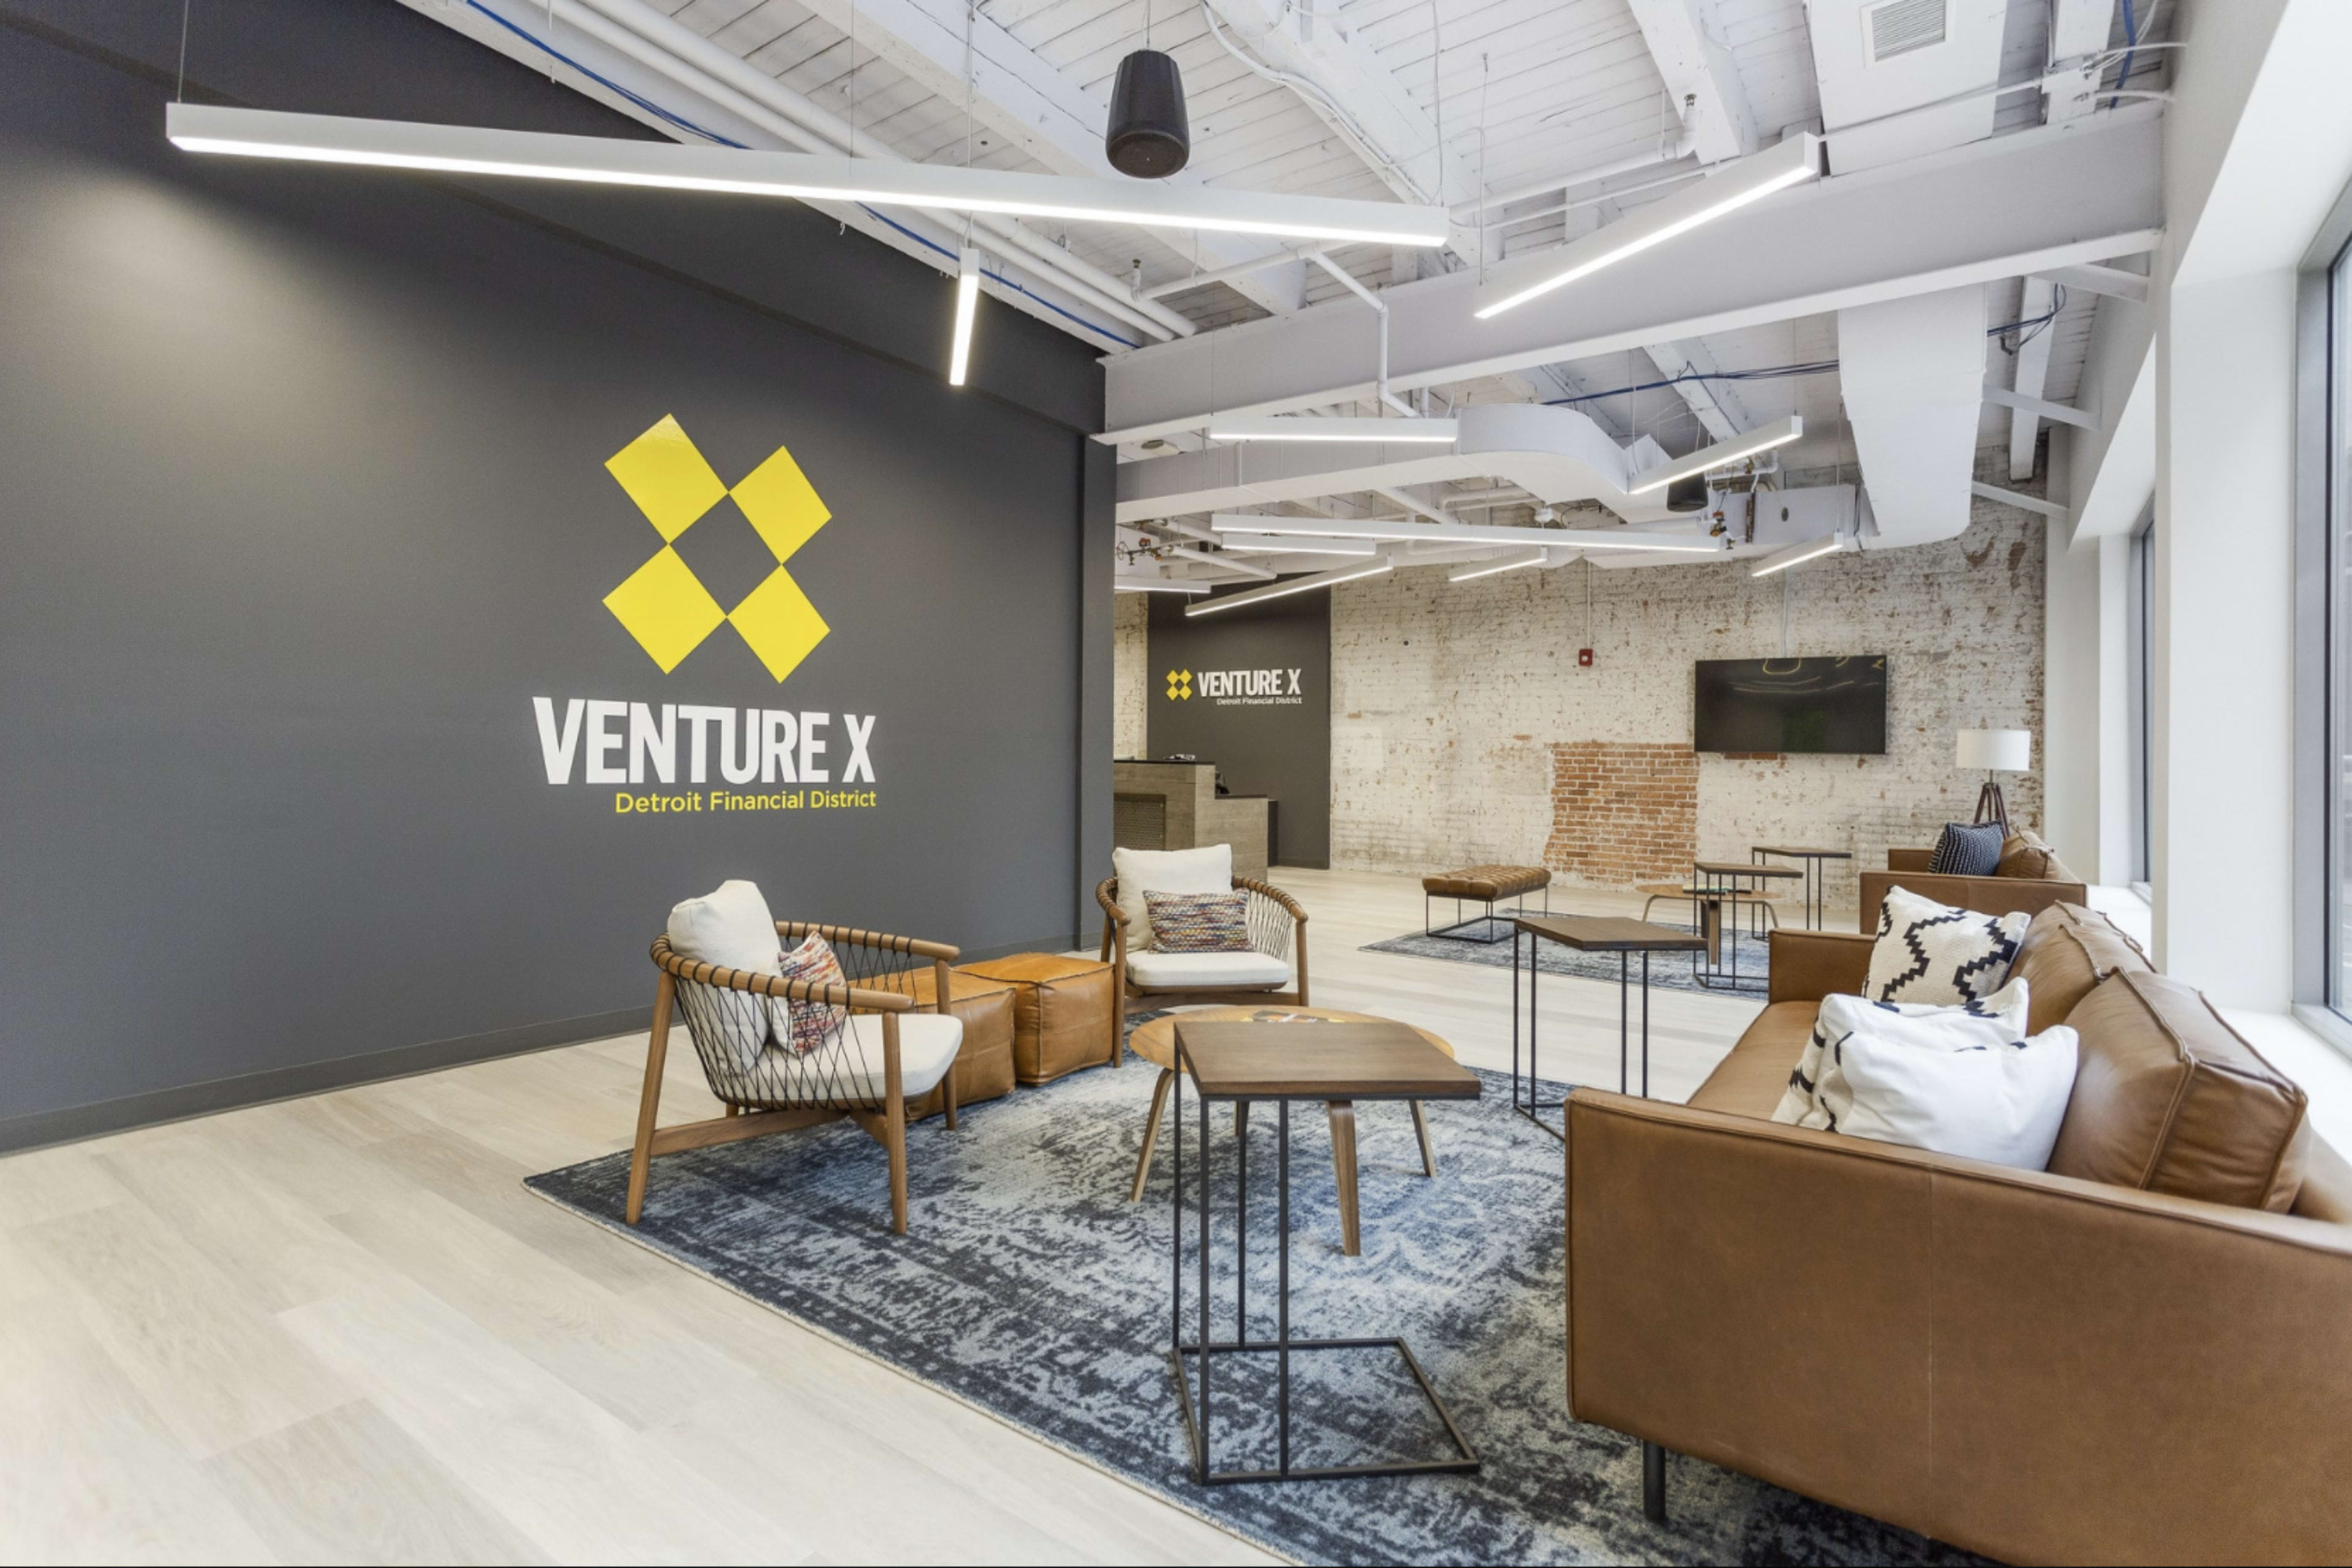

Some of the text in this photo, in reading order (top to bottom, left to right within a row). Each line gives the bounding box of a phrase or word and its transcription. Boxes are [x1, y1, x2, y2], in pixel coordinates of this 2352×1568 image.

[1197, 668, 1302, 697] VENTURE X
[532, 696, 876, 784] VENTURE X
[614, 790, 876, 813] Detroit Financial District
